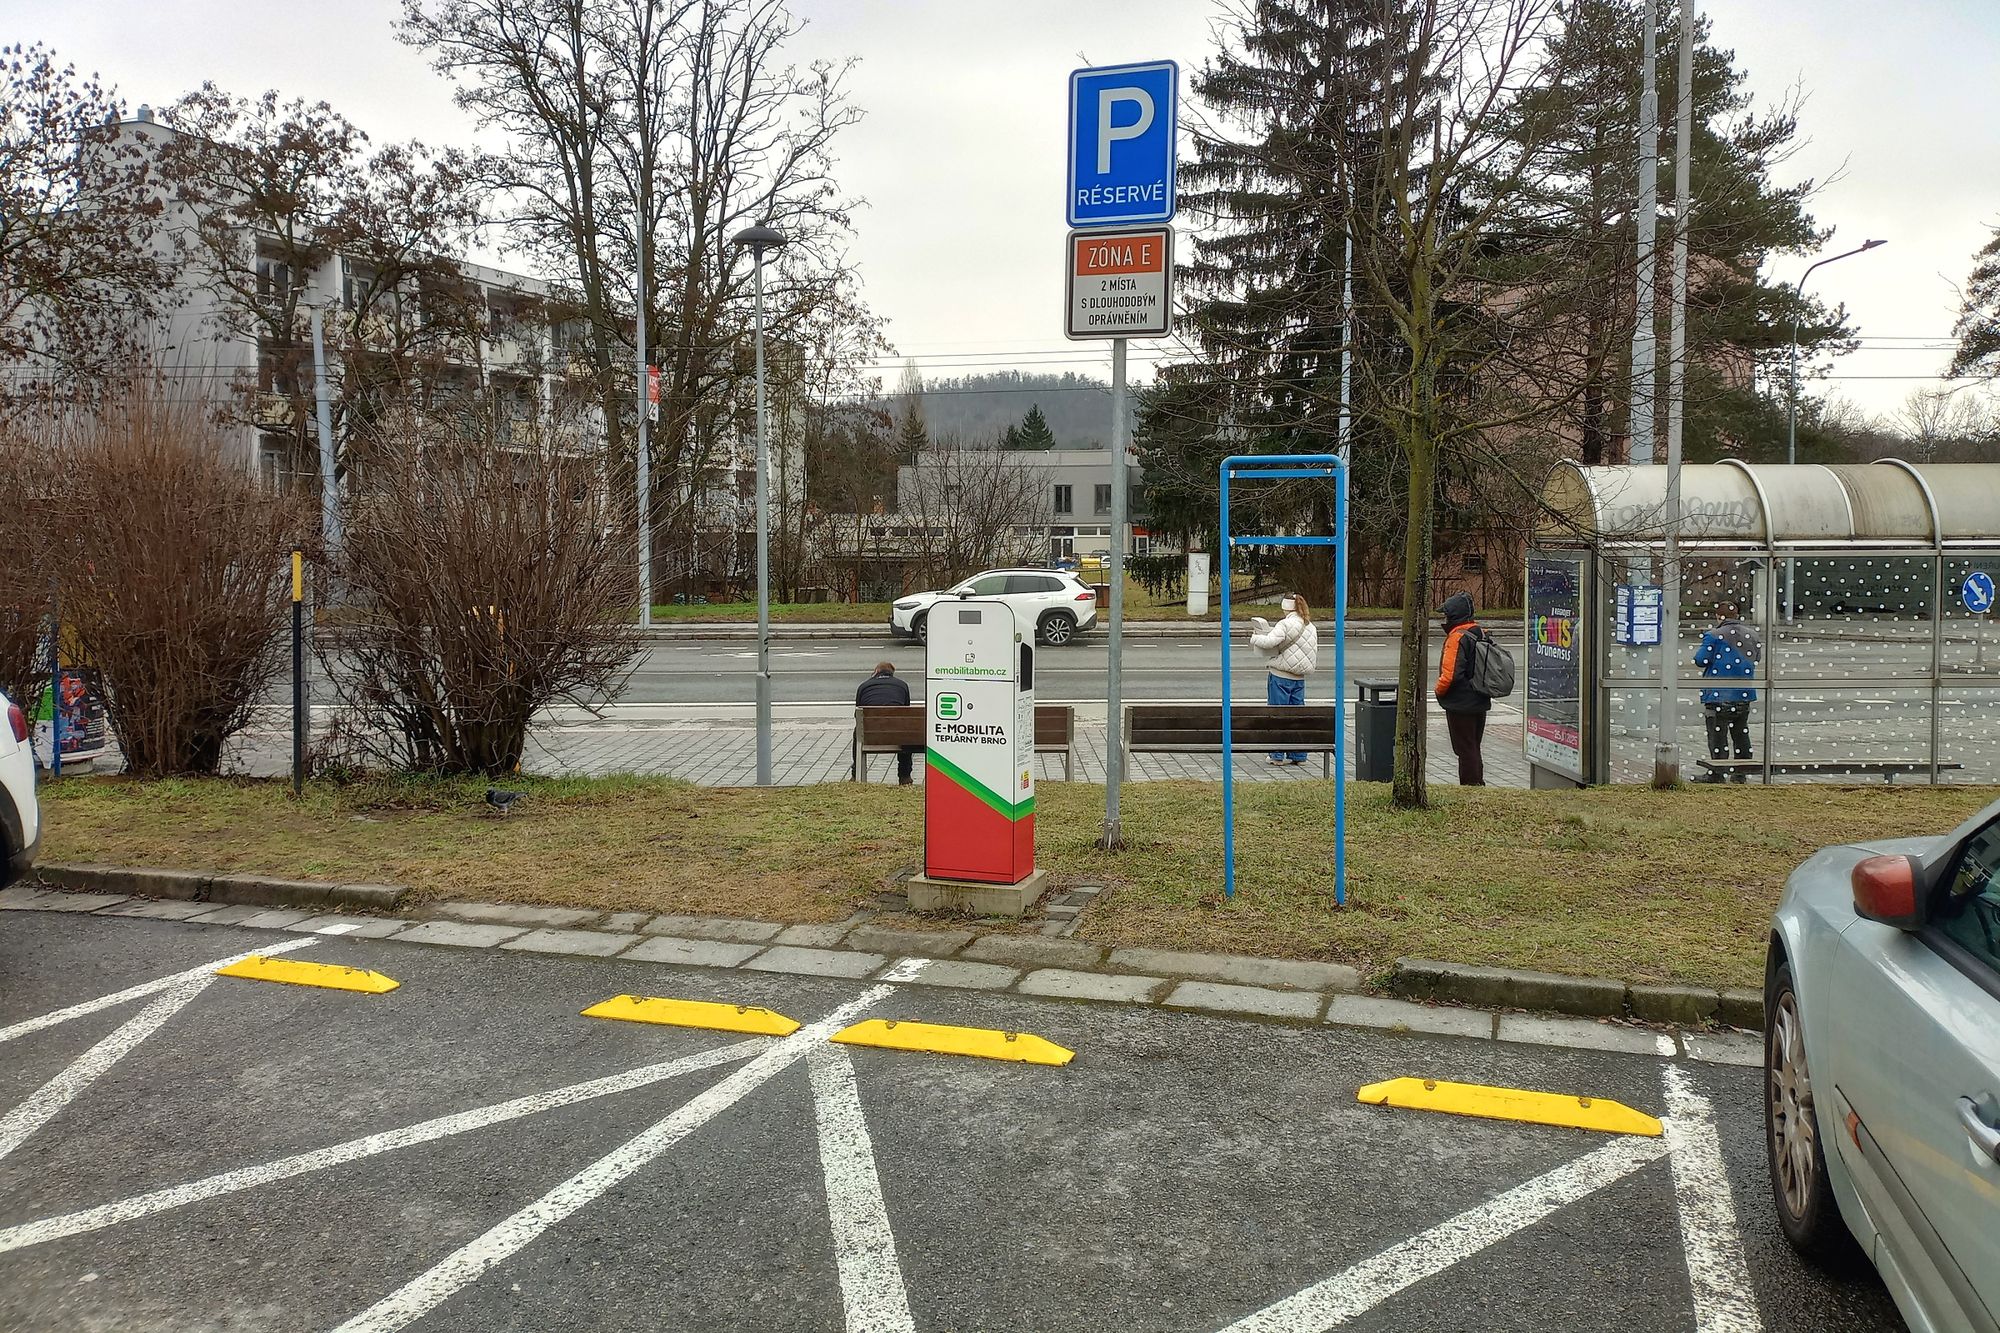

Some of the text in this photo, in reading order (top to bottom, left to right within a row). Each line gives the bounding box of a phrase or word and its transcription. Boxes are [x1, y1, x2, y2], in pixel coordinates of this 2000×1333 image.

[1097, 86, 1155, 175] P
[1078, 179, 1164, 206] RÉSERVÉ
[1088, 241, 1151, 268] ZÓNA E
[1101, 277, 1137, 292] 2 MÍSTA
[1081, 292, 1156, 309] S DLOUHODOBÝM
[1088, 309, 1148, 326] OPRÁVNĚNÍM
[935, 666, 1007, 676] emobilitabrno.cz
[935, 723, 1004, 736] E-MOBILITA
[935, 734, 1007, 745] TEPLÁRNY BRNO
